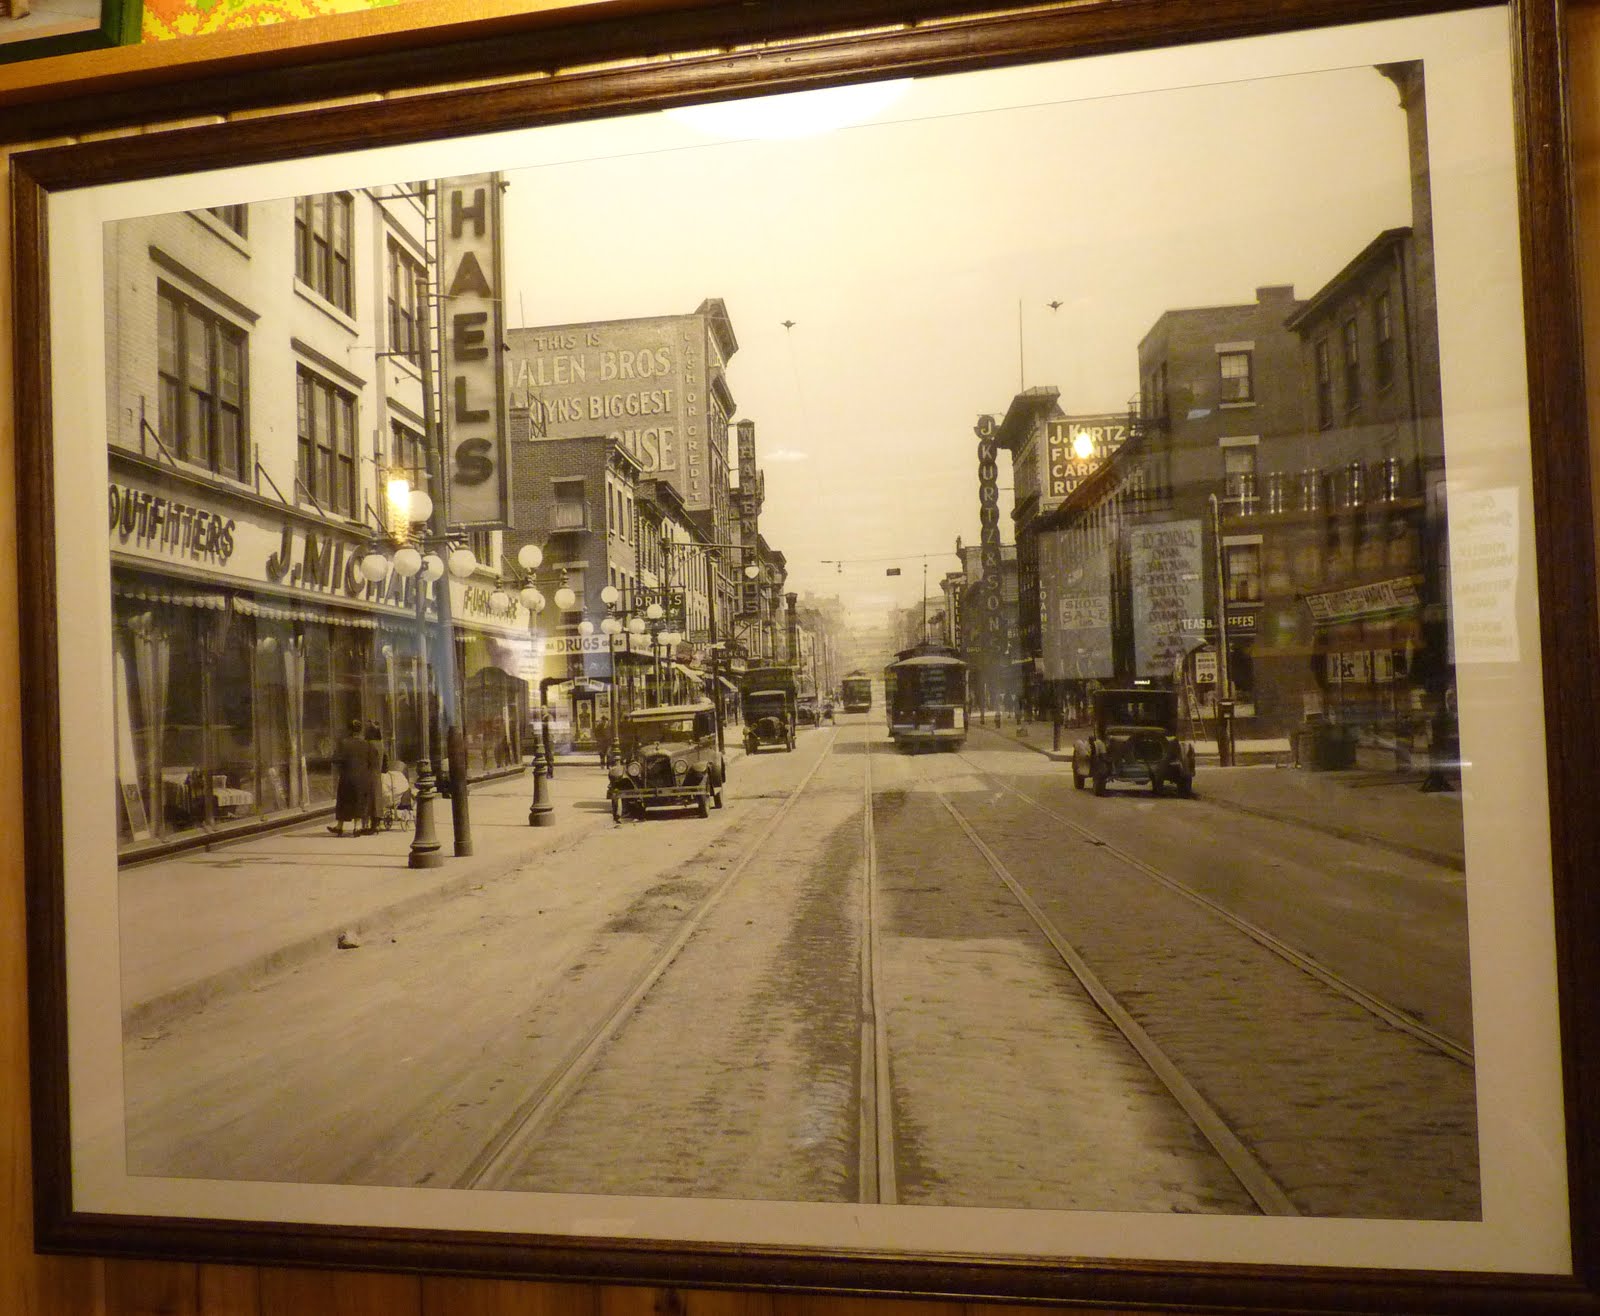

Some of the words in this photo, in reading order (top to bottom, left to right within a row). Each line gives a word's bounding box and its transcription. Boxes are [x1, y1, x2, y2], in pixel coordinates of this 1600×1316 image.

[449, 188, 493, 486] HAELS
[534, 334, 577, 352] THIS
[586, 332, 601, 347] IS
[600, 346, 677, 381] BROS.
[589, 389, 673, 420] BIGGEST
[687, 425, 700, 502] CREDIT
[108, 483, 236, 566] OUTFITTERS
[635, 594, 682, 607] DRUS
[1040, 580, 1048, 633] LOANS
[1182, 618, 1206, 629] TEAS
[557, 637, 600, 653] DRUGS
[1199, 672, 1214, 682] 29
